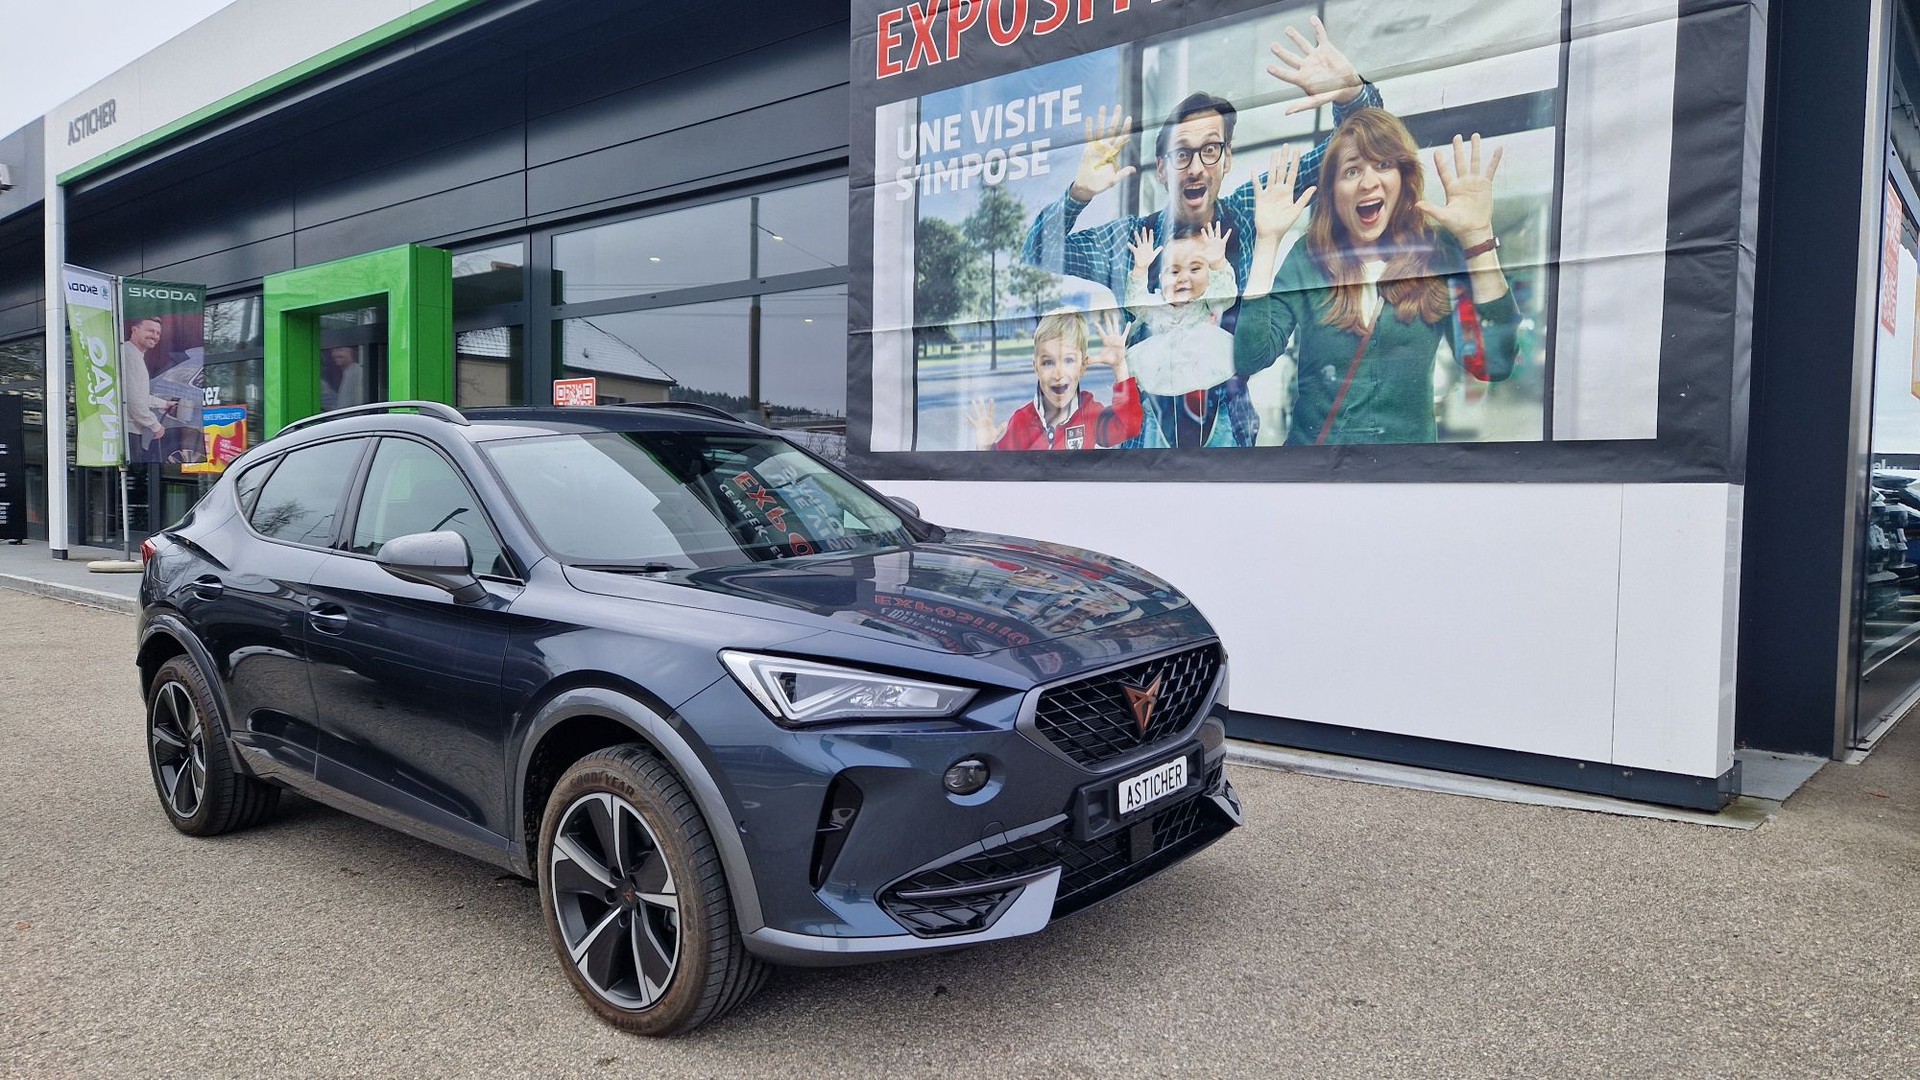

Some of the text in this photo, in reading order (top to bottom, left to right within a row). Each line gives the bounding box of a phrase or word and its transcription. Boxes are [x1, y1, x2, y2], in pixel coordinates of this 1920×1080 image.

[876, 0, 1131, 79] EXPOS
[67, 98, 117, 146] ASTICHER
[896, 84, 1084, 160] UNE VISITE
[895, 139, 1050, 201] S'IMPOSE
[1126, 763, 1182, 810] ASTICHER
